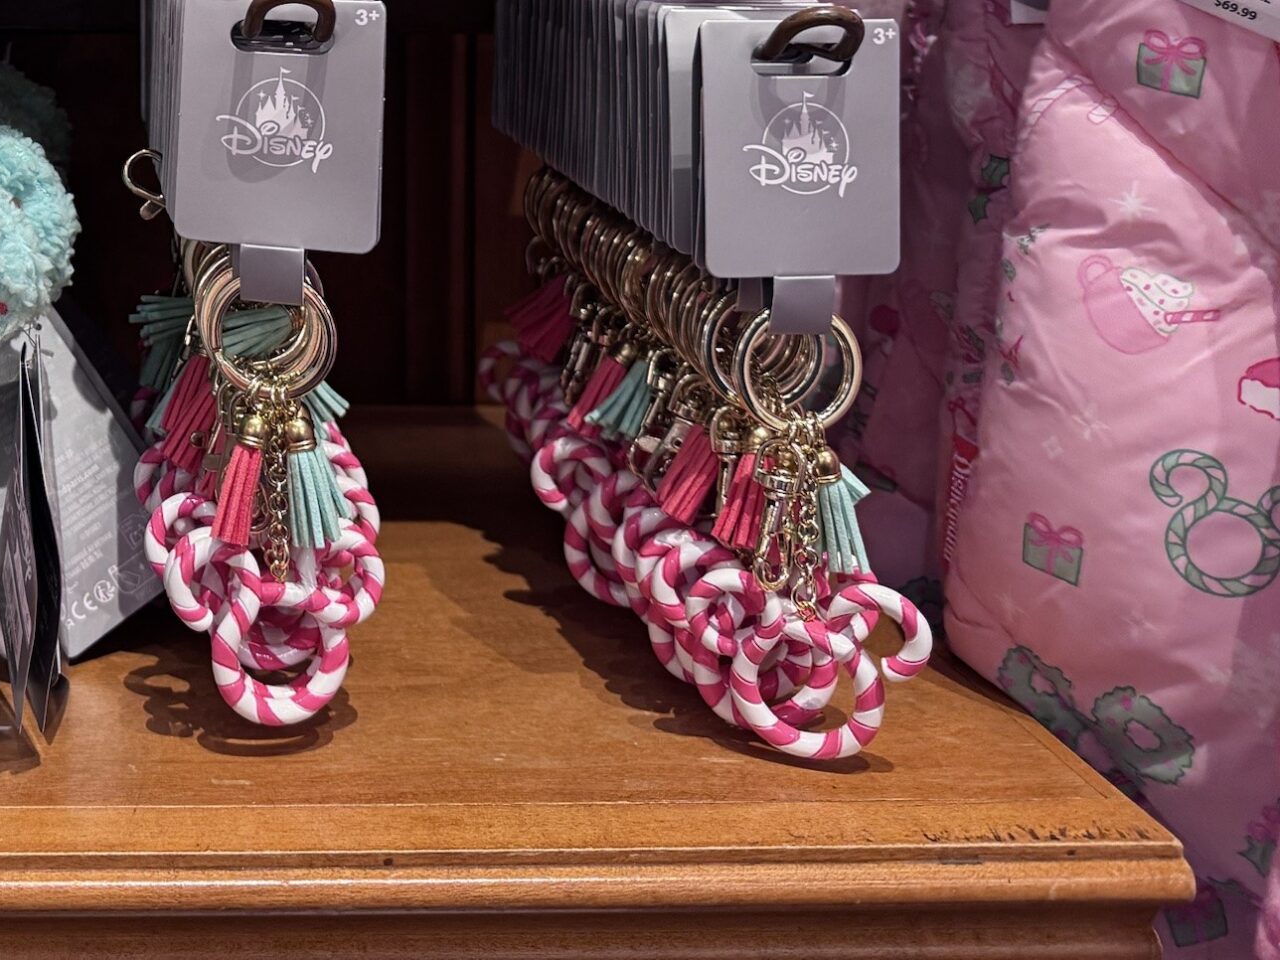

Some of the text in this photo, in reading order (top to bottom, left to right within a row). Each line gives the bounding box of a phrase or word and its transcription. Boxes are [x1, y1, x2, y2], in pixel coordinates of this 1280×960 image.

[354, 9, 380, 26] 3+
[872, 27, 897, 45] 3+
[216, 115, 334, 174] Disney
[742, 144, 858, 198] Disney
